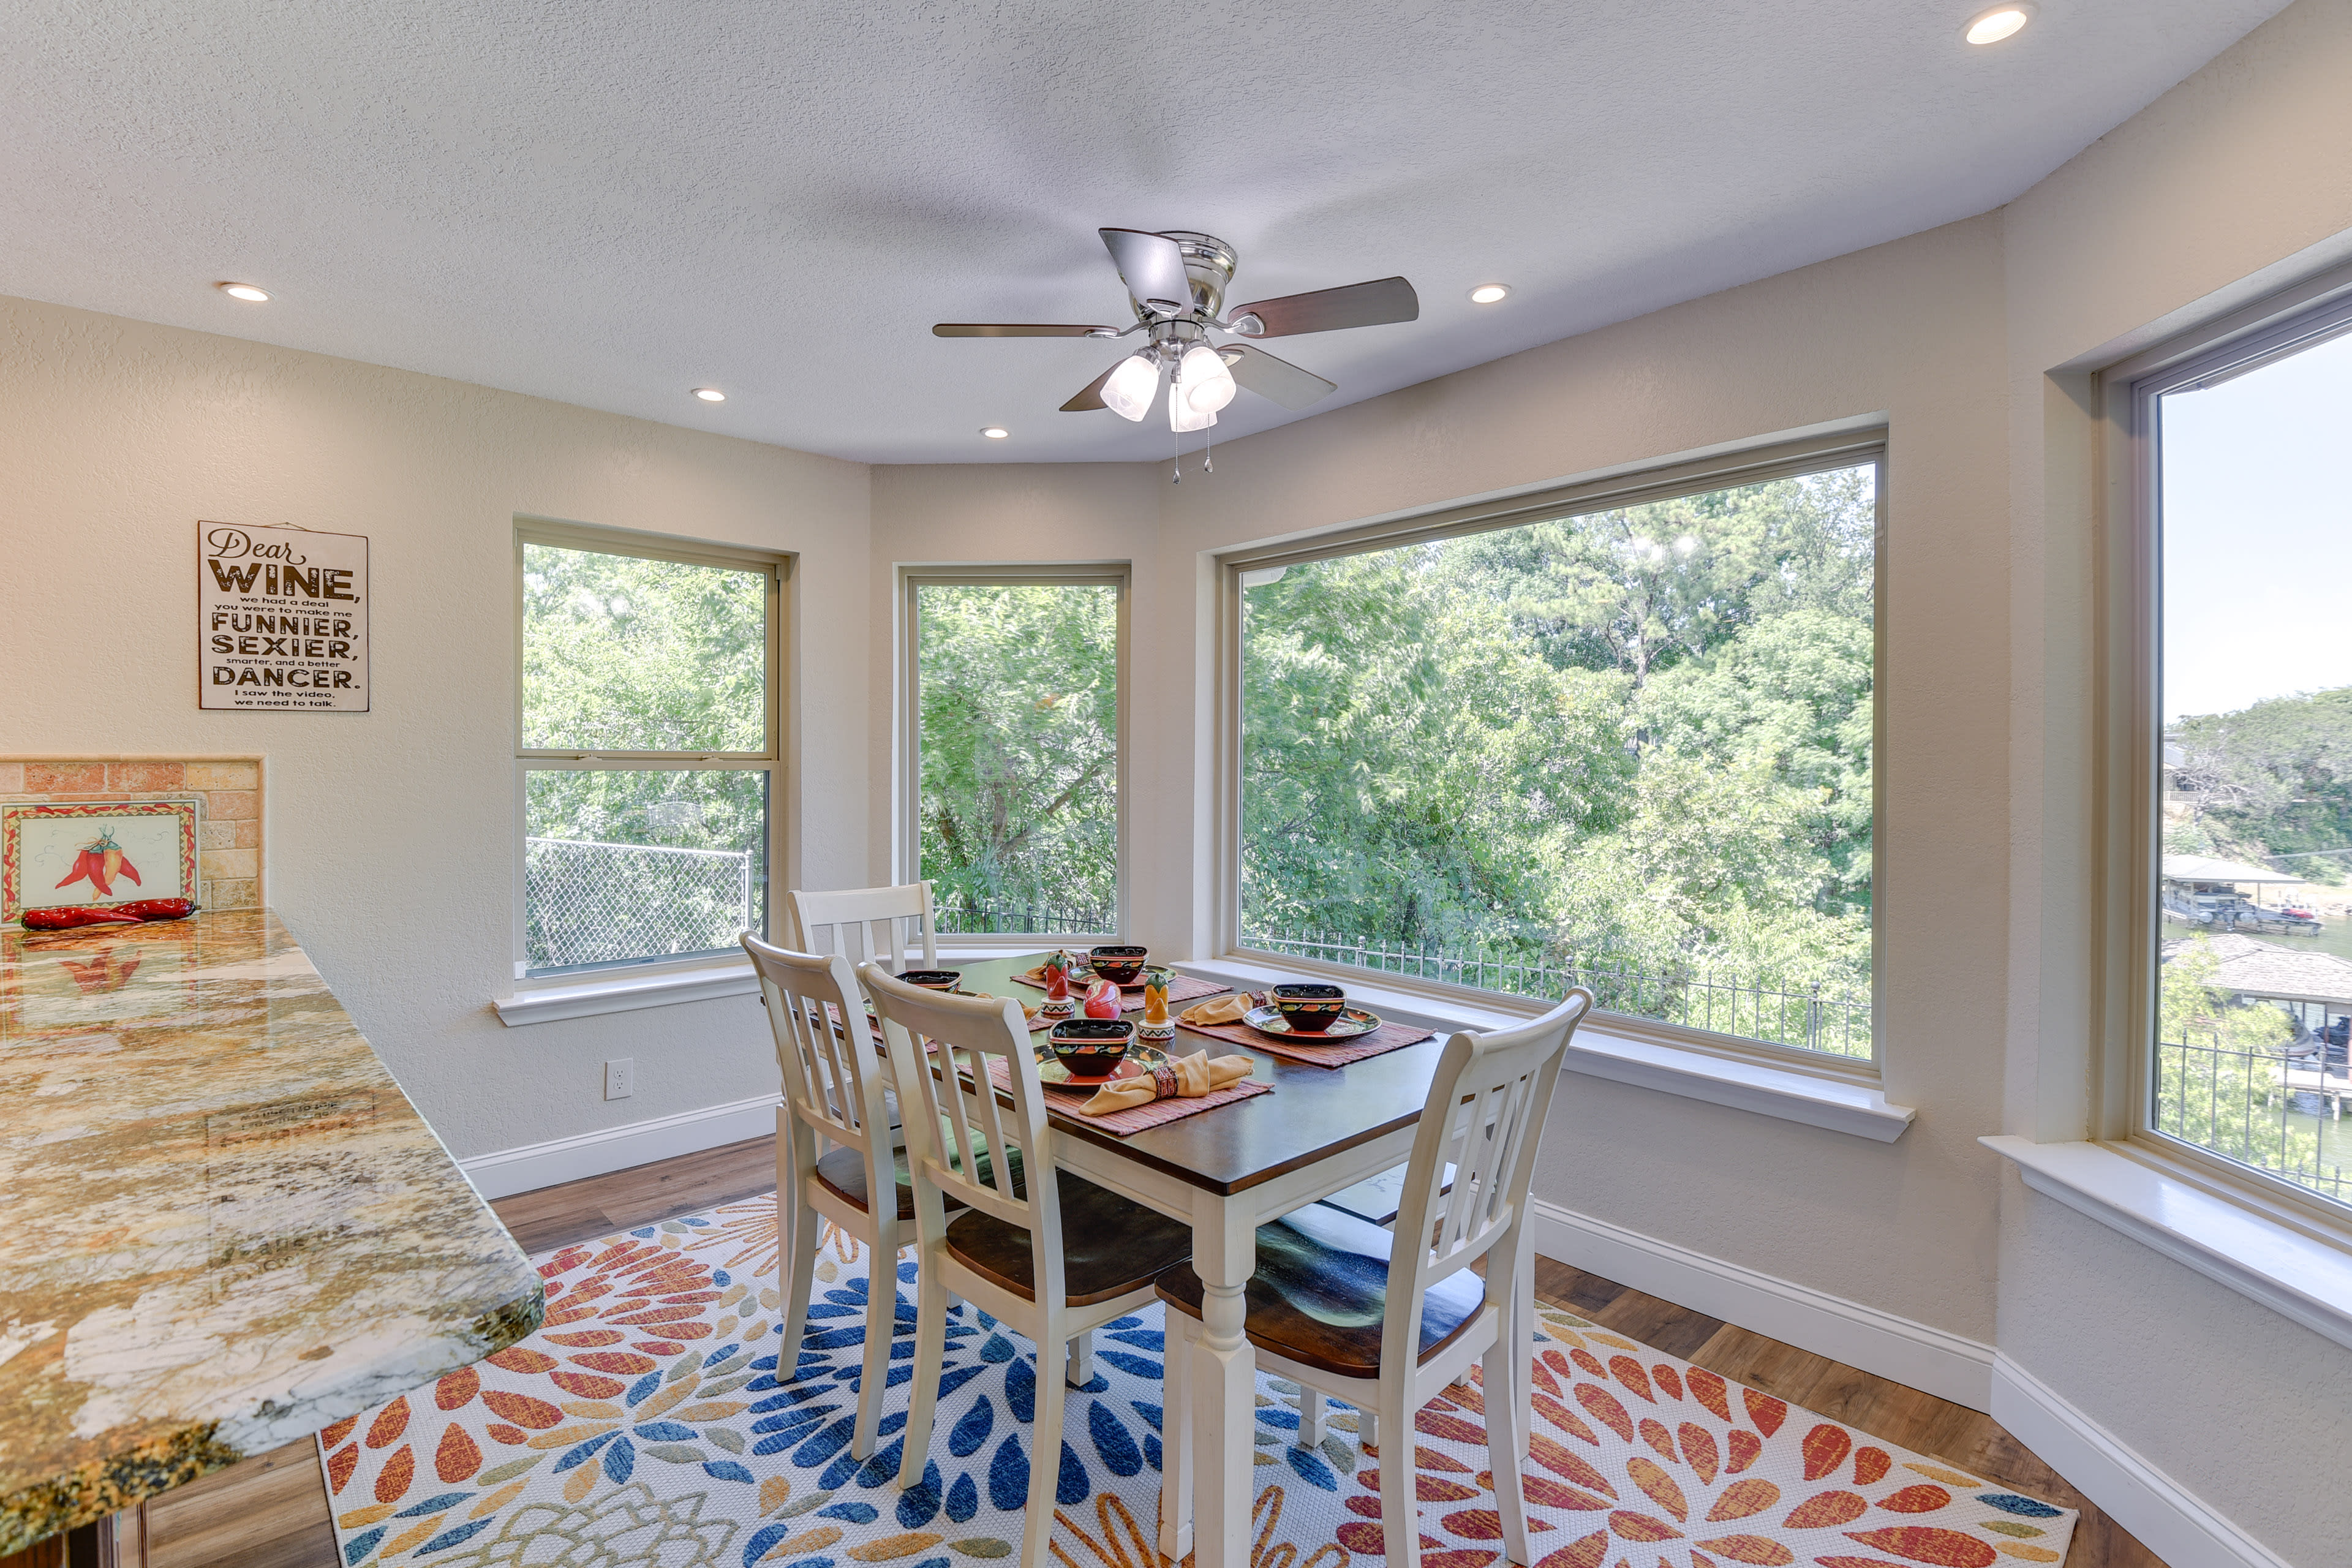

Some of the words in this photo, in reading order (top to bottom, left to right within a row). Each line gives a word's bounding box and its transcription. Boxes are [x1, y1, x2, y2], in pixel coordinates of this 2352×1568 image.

[208, 529, 306, 565] Dear
[208, 559, 360, 603] WINE,
[212, 612, 358, 639] FUNNIER,
[211, 635, 358, 661] SEXIER,
[213, 666, 360, 689] DANCER.
